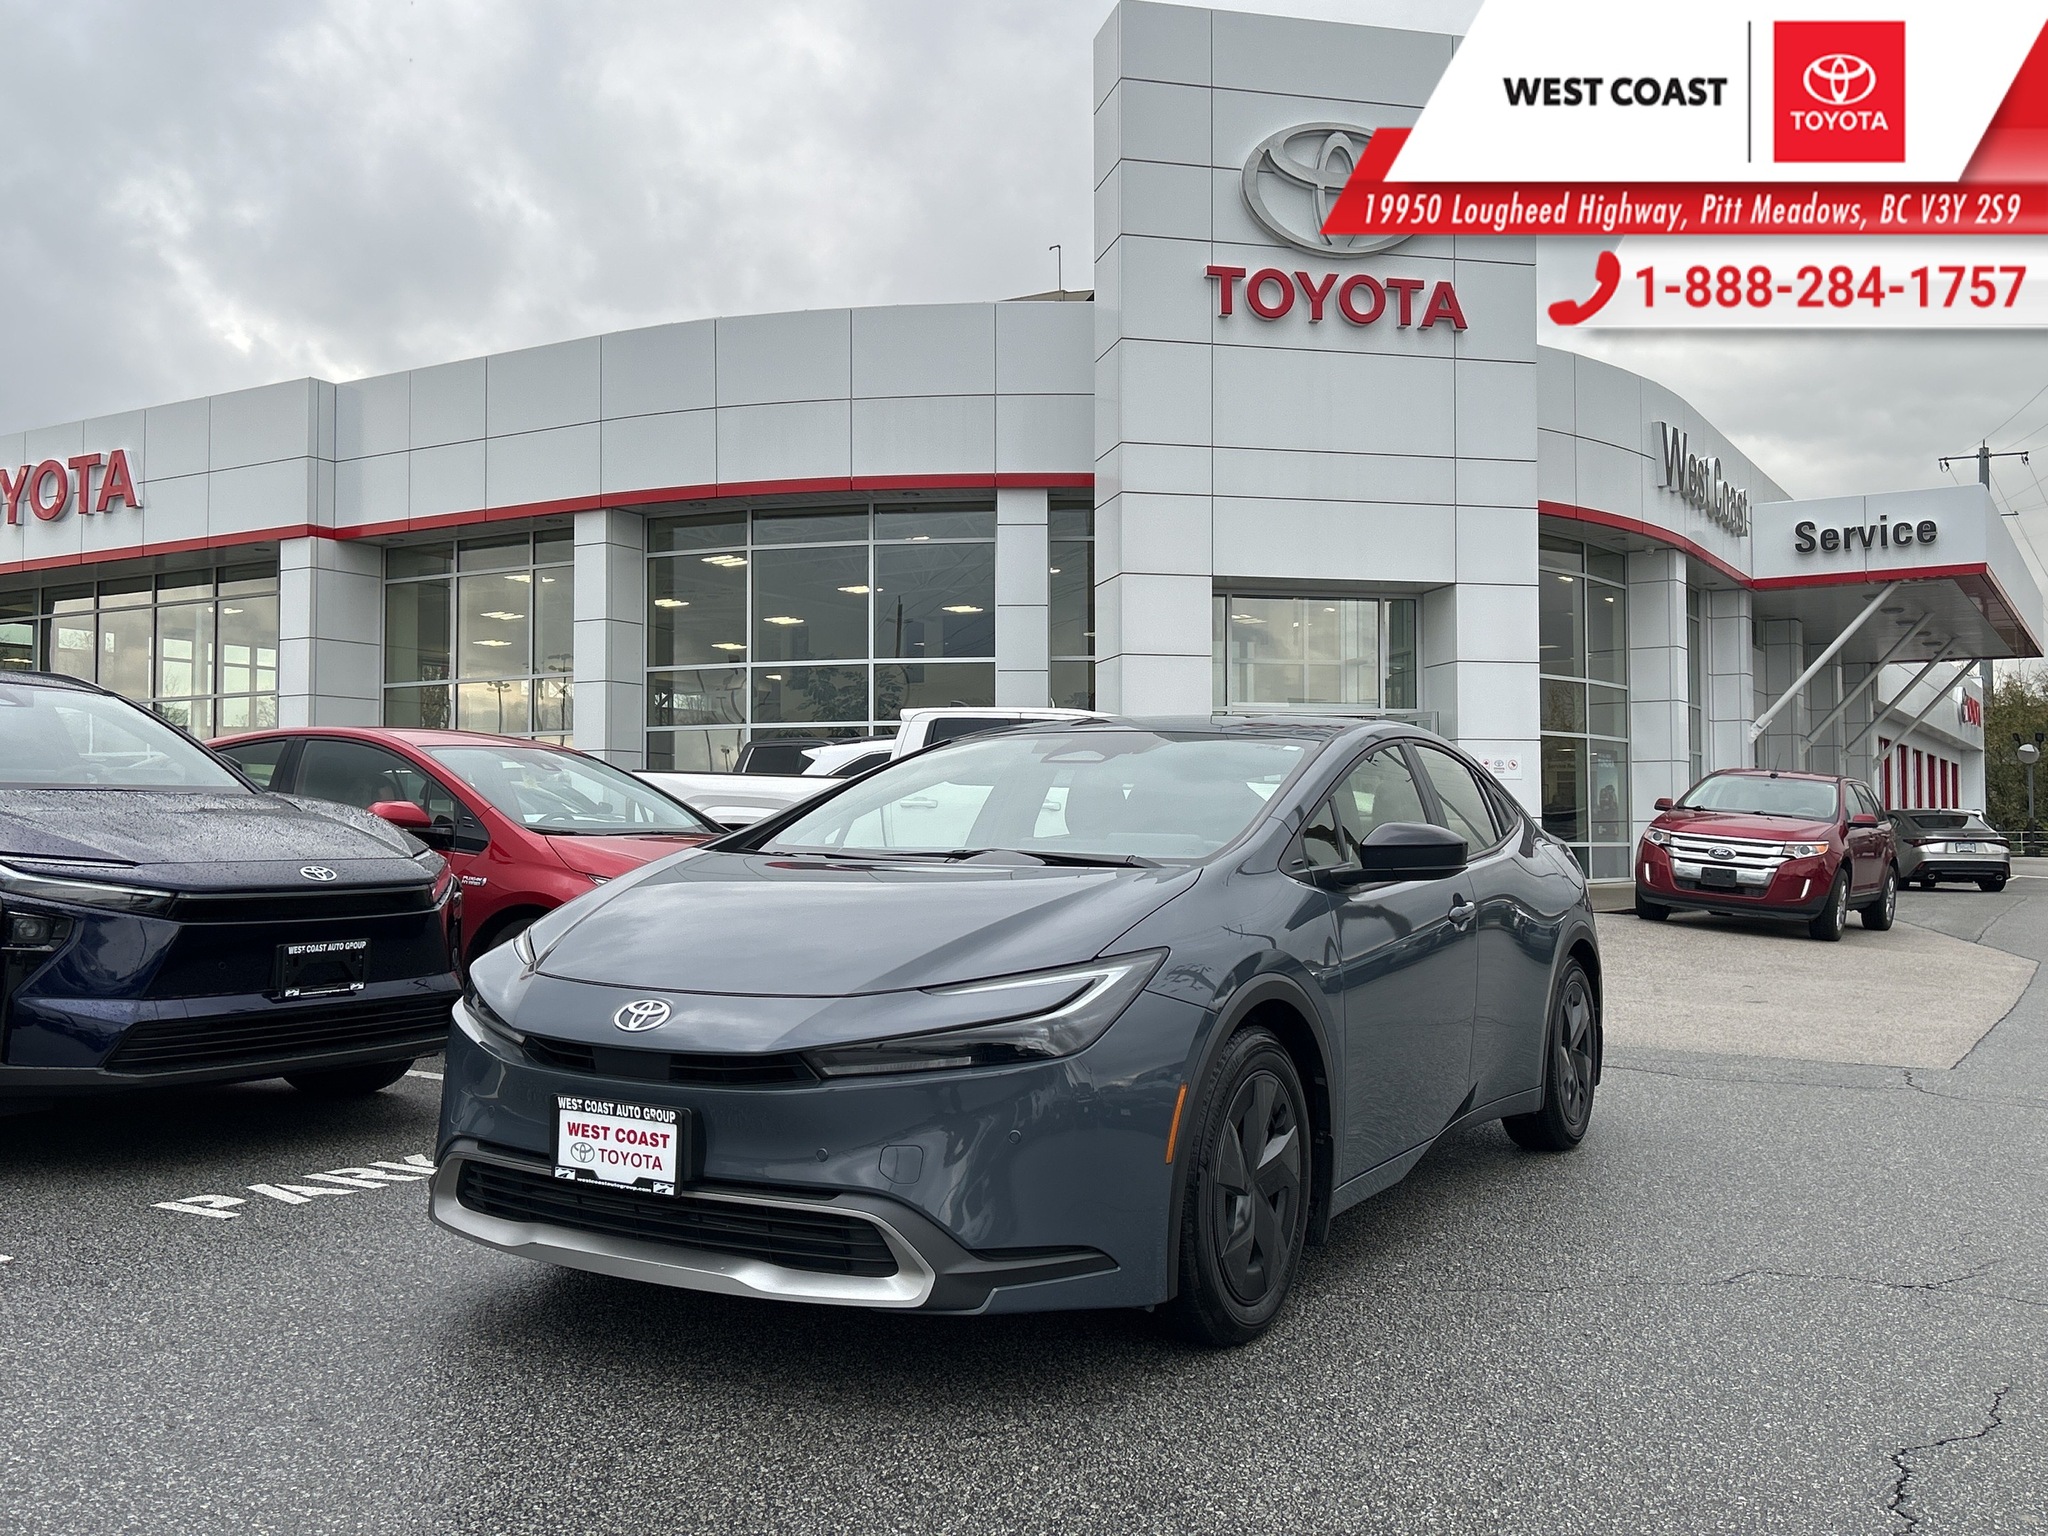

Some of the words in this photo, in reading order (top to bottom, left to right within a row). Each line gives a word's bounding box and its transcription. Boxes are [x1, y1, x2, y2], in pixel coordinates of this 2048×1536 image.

[1204, 264, 1468, 332] TOYOTA
[1653, 421, 1709, 511] West
[1709, 457, 1748, 537] Coast
[1794, 514, 1938, 554] Service
[288, 946, 306, 954] WEST
[306, 944, 327, 953] COAST
[327, 942, 344, 952] AUTO
[344, 941, 367, 950] GROUP
[557, 1096, 582, 1110] WEST
[584, 1099, 615, 1115] COAST
[616, 1104, 641, 1119] AUTO
[643, 1107, 676, 1123] GROUP
[567, 1121, 610, 1141] WEST
[615, 1127, 670, 1149] COAST
[598, 1147, 663, 1171] TOYOTA
